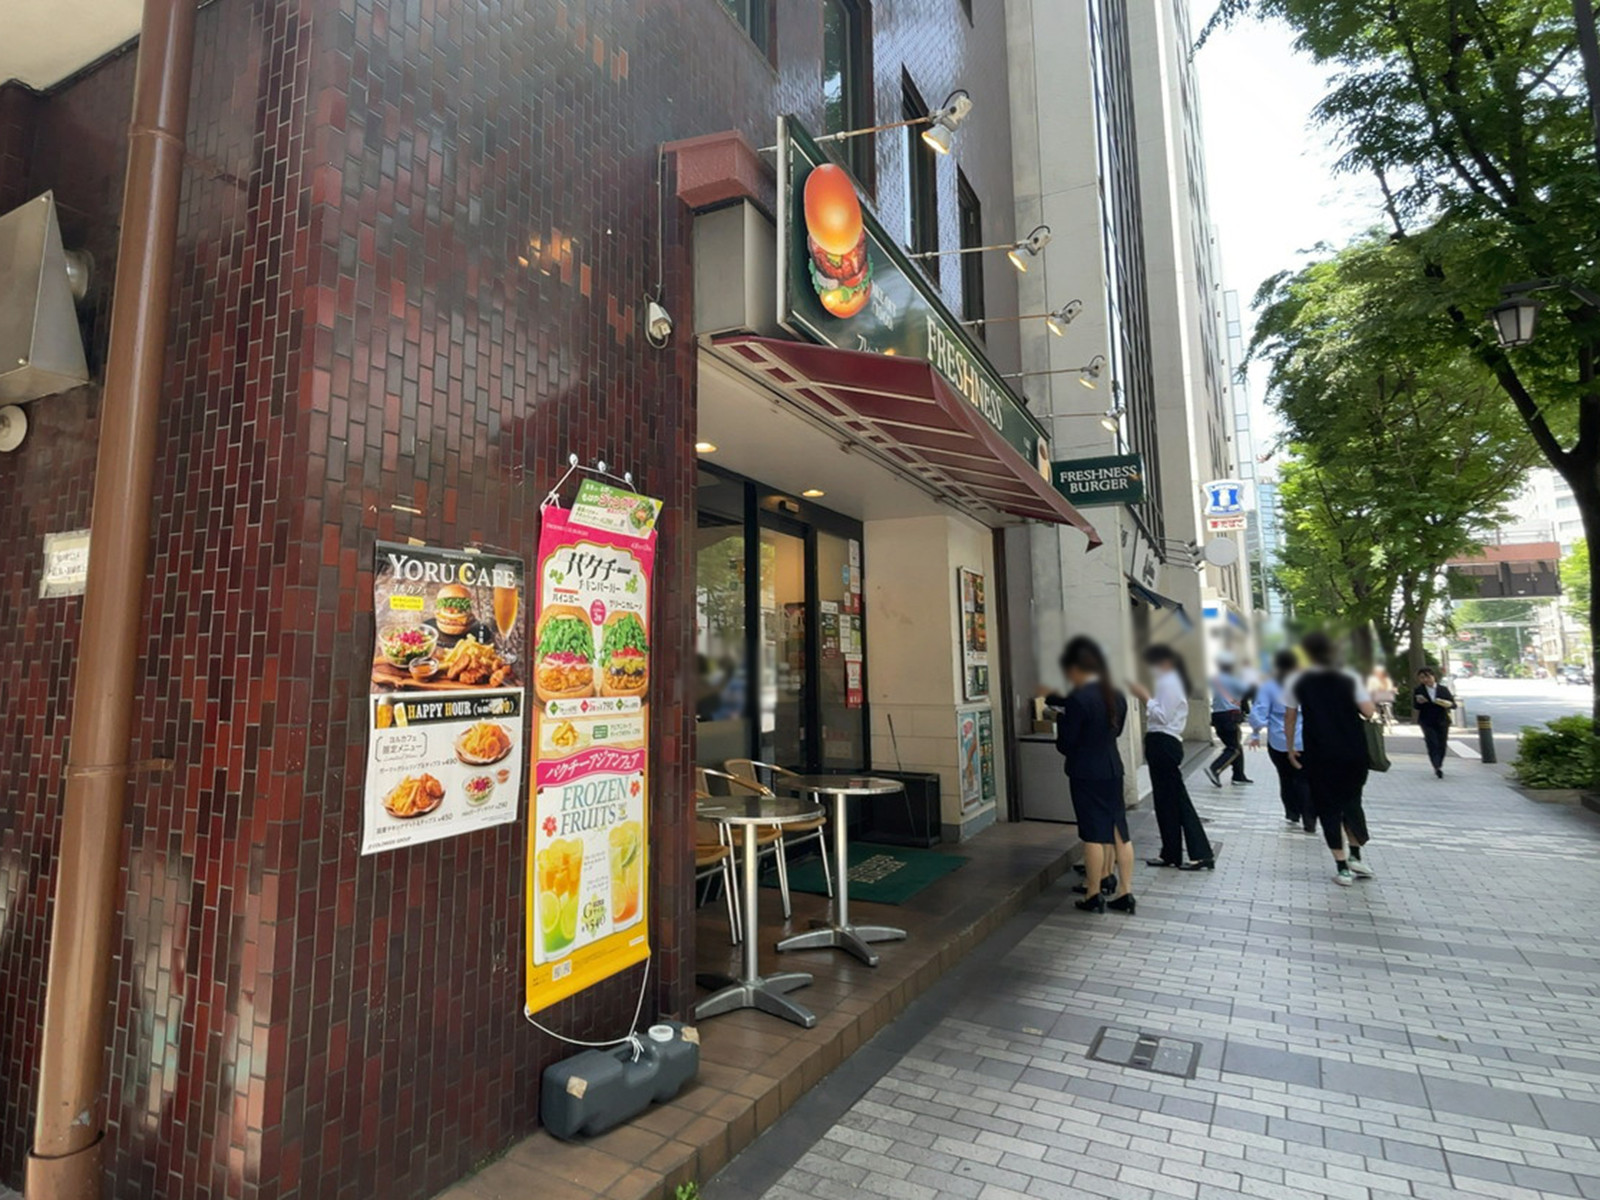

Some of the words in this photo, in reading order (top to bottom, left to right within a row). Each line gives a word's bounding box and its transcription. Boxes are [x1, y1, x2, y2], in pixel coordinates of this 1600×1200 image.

[926, 315, 1003, 431] FRESHNESS
[1060, 465, 1138, 483] FRESHNESS
[1070, 478, 1129, 494] BURGER
[388, 553, 455, 584] YORU
[458, 562, 516, 588] CAFE
[565, 551, 631, 581] パクチー
[407, 703, 443, 719] HAPPY
[445, 701, 471, 717] HOUR
[545, 750, 641, 781] パクチーアジアンフェア
[560, 776, 630, 812] FROZEN
[560, 803, 616, 836] FRUITS
